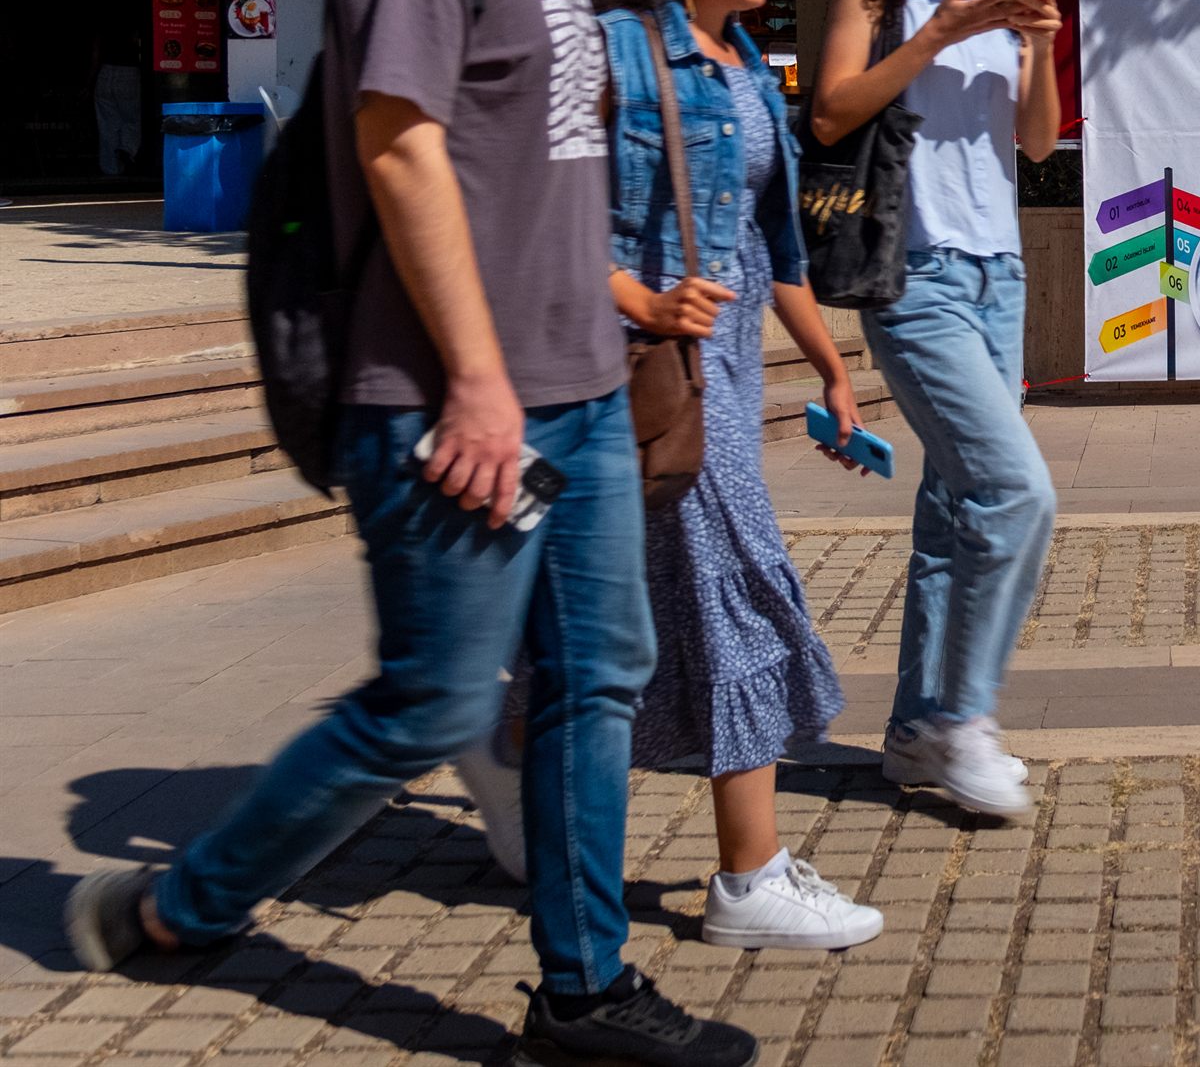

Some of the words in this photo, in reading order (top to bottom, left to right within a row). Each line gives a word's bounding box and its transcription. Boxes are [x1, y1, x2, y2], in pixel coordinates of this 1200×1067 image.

[1109, 205, 1120, 220] 01
[1176, 197, 1191, 215] 04
[1177, 237, 1191, 254] 05
[1105, 256, 1118, 272] 02
[1168, 275, 1183, 291] 06
[1113, 324, 1126, 340] 03
